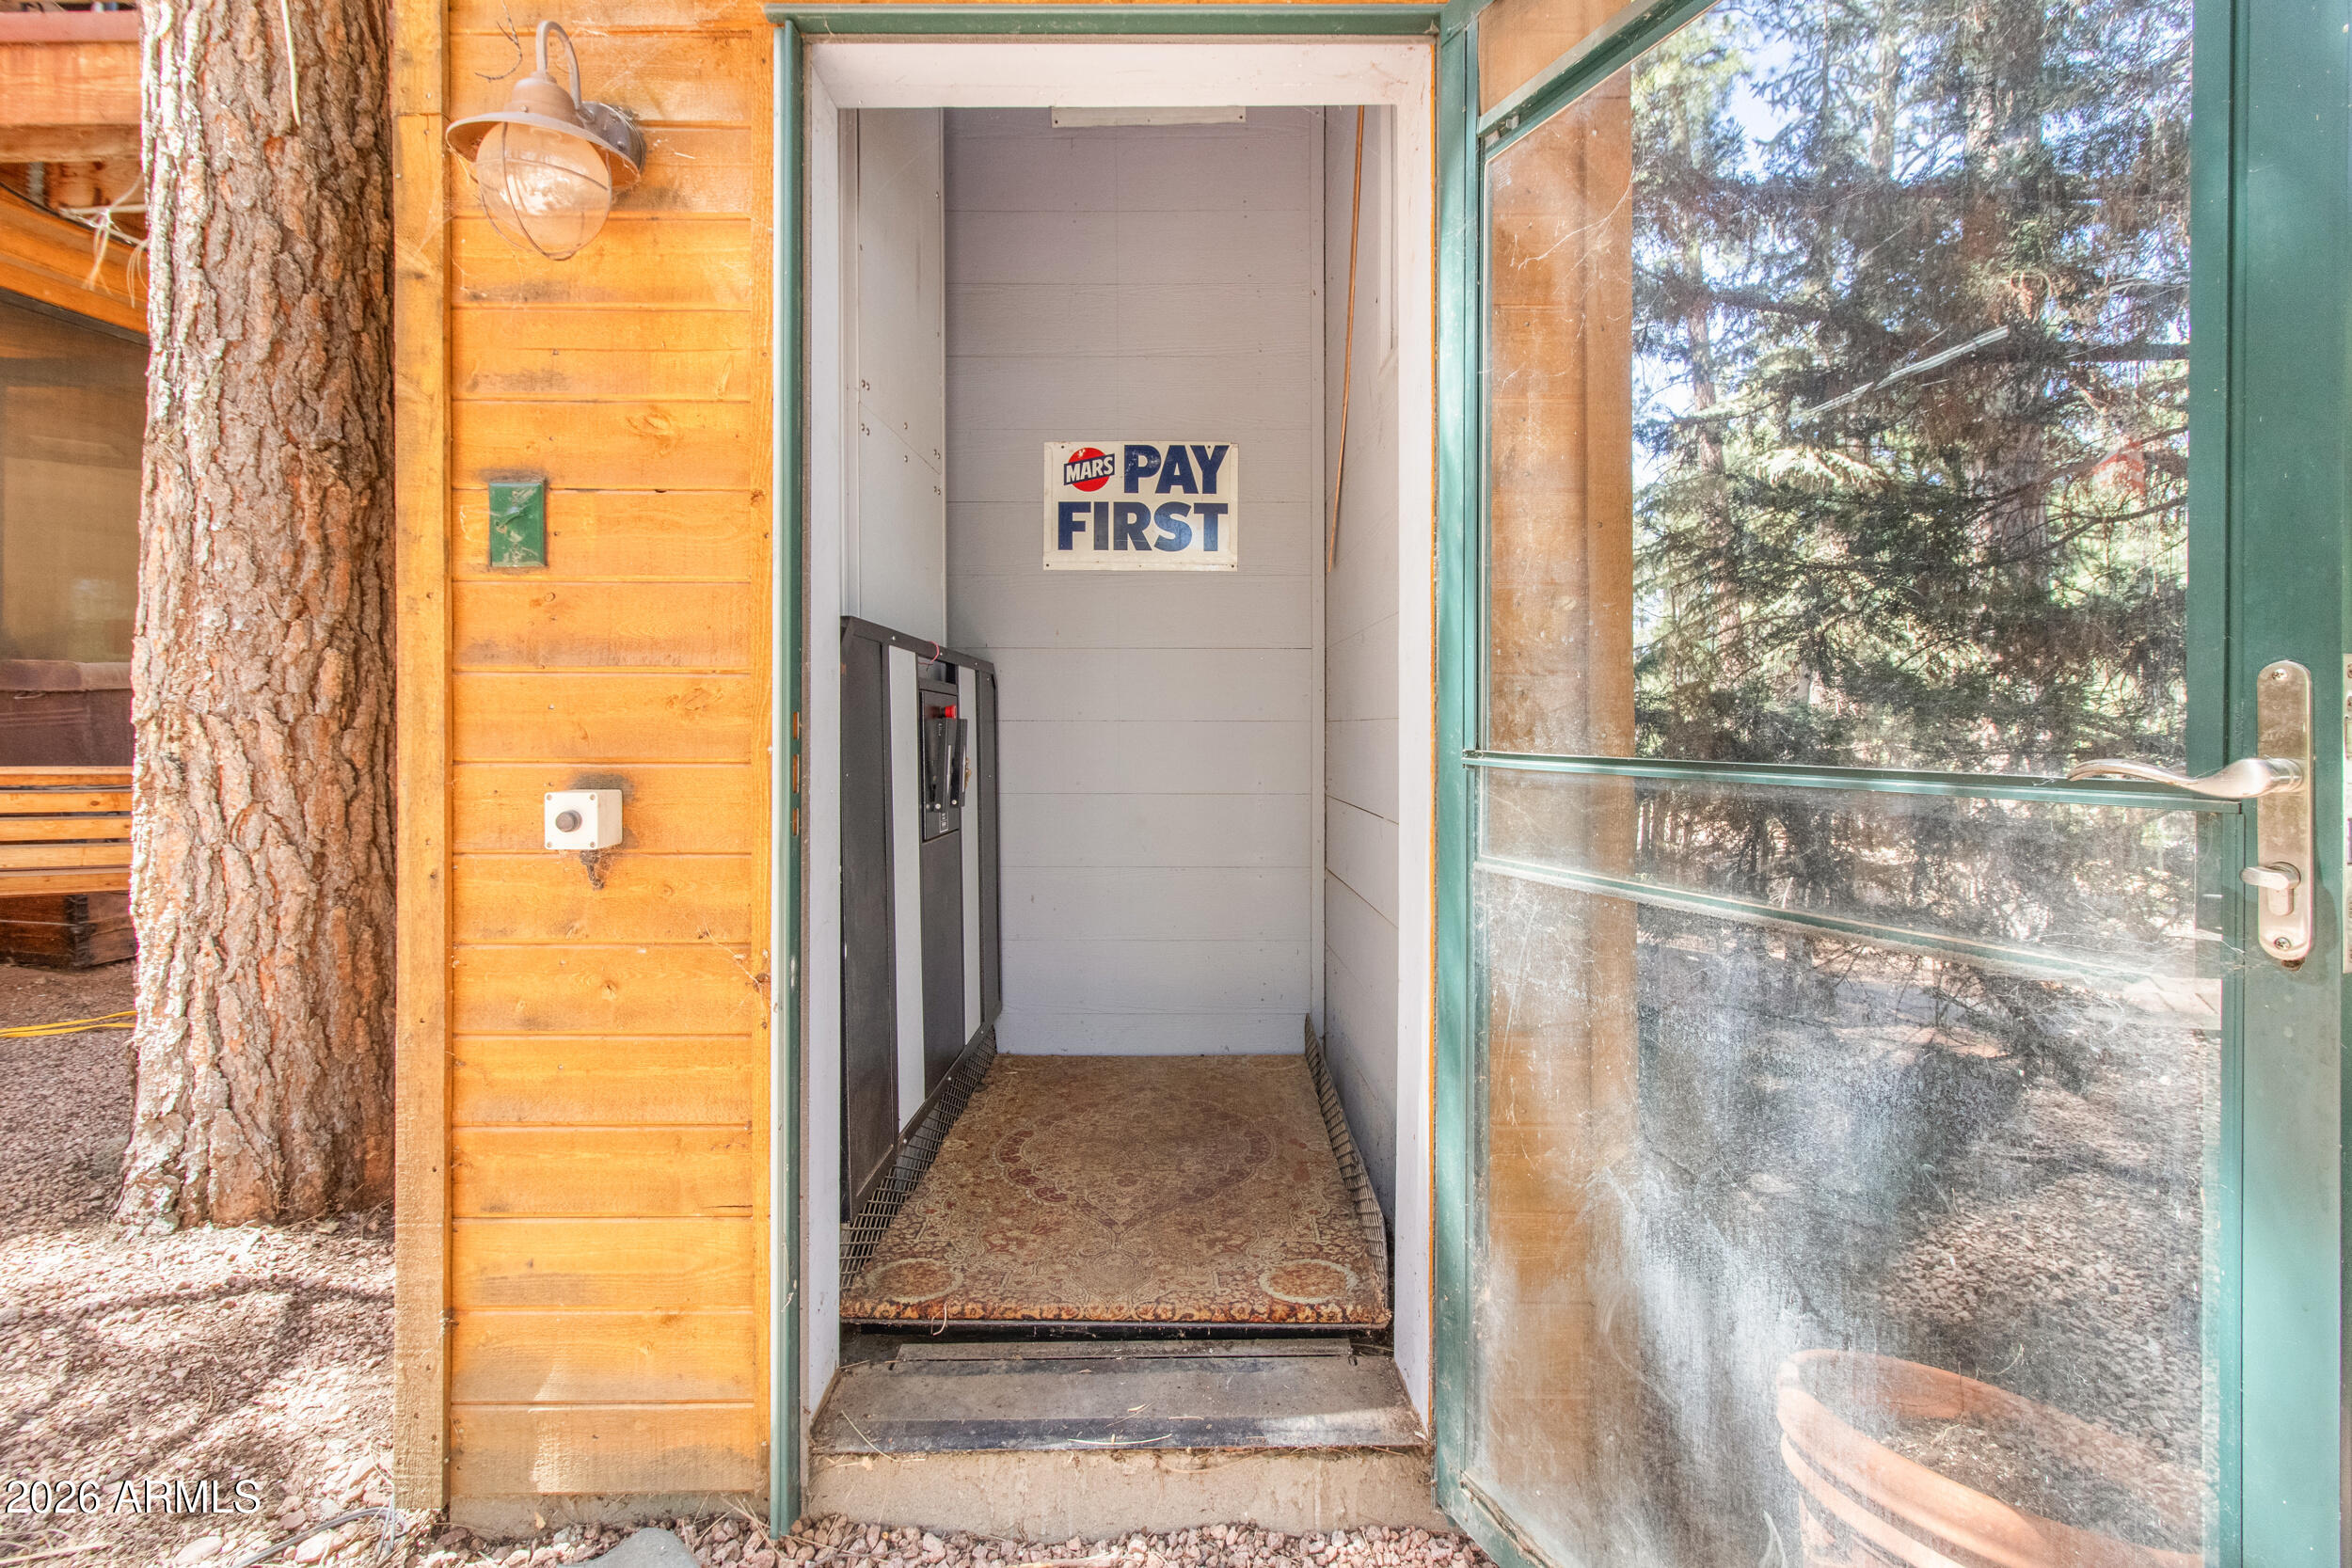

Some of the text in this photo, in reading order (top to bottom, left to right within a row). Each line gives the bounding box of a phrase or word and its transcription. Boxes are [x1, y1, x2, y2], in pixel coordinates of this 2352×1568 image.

[1065, 455, 1114, 483] MARS
[1124, 444, 1230, 494] PAY
[1058, 501, 1229, 551] FIRST
